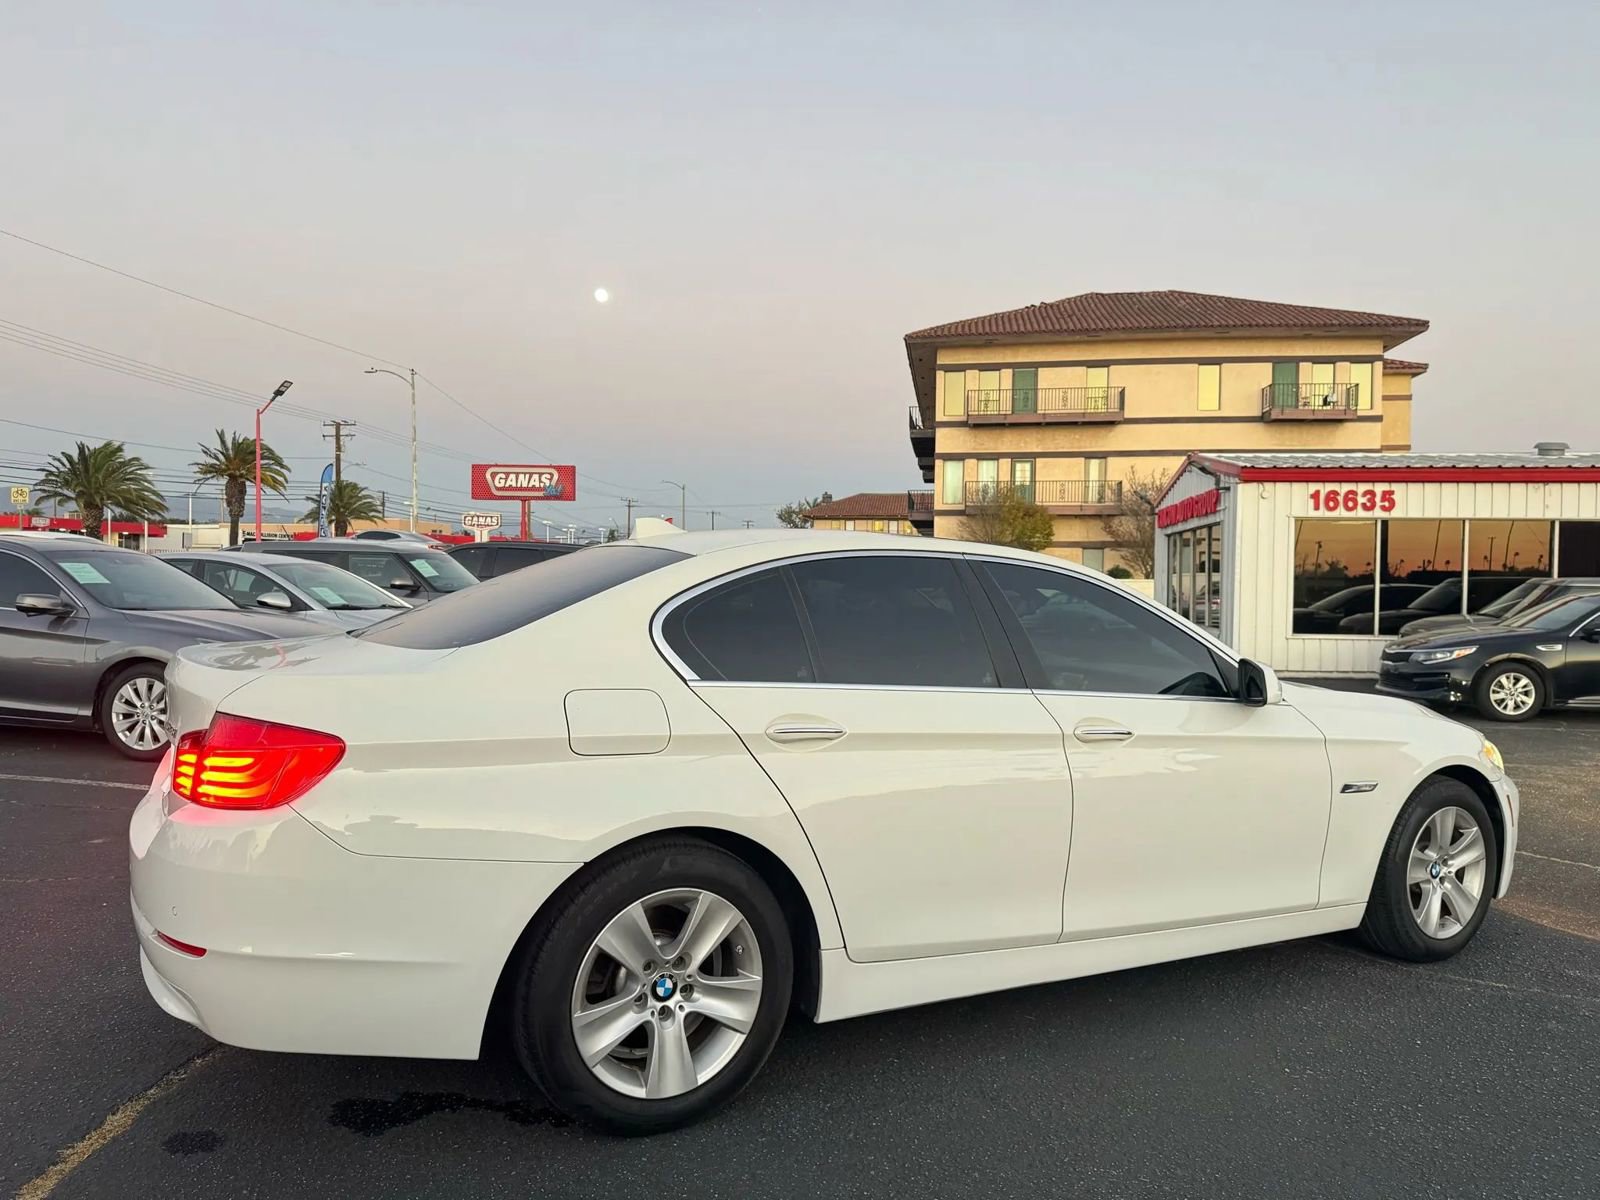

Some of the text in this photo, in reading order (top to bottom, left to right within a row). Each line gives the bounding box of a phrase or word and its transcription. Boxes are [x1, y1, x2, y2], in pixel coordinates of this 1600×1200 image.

[494, 473, 551, 488] GANAS
[1193, 489, 1219, 516] GROUP
[1309, 489, 1396, 512] 16635
[464, 516, 498, 526] GANAS
